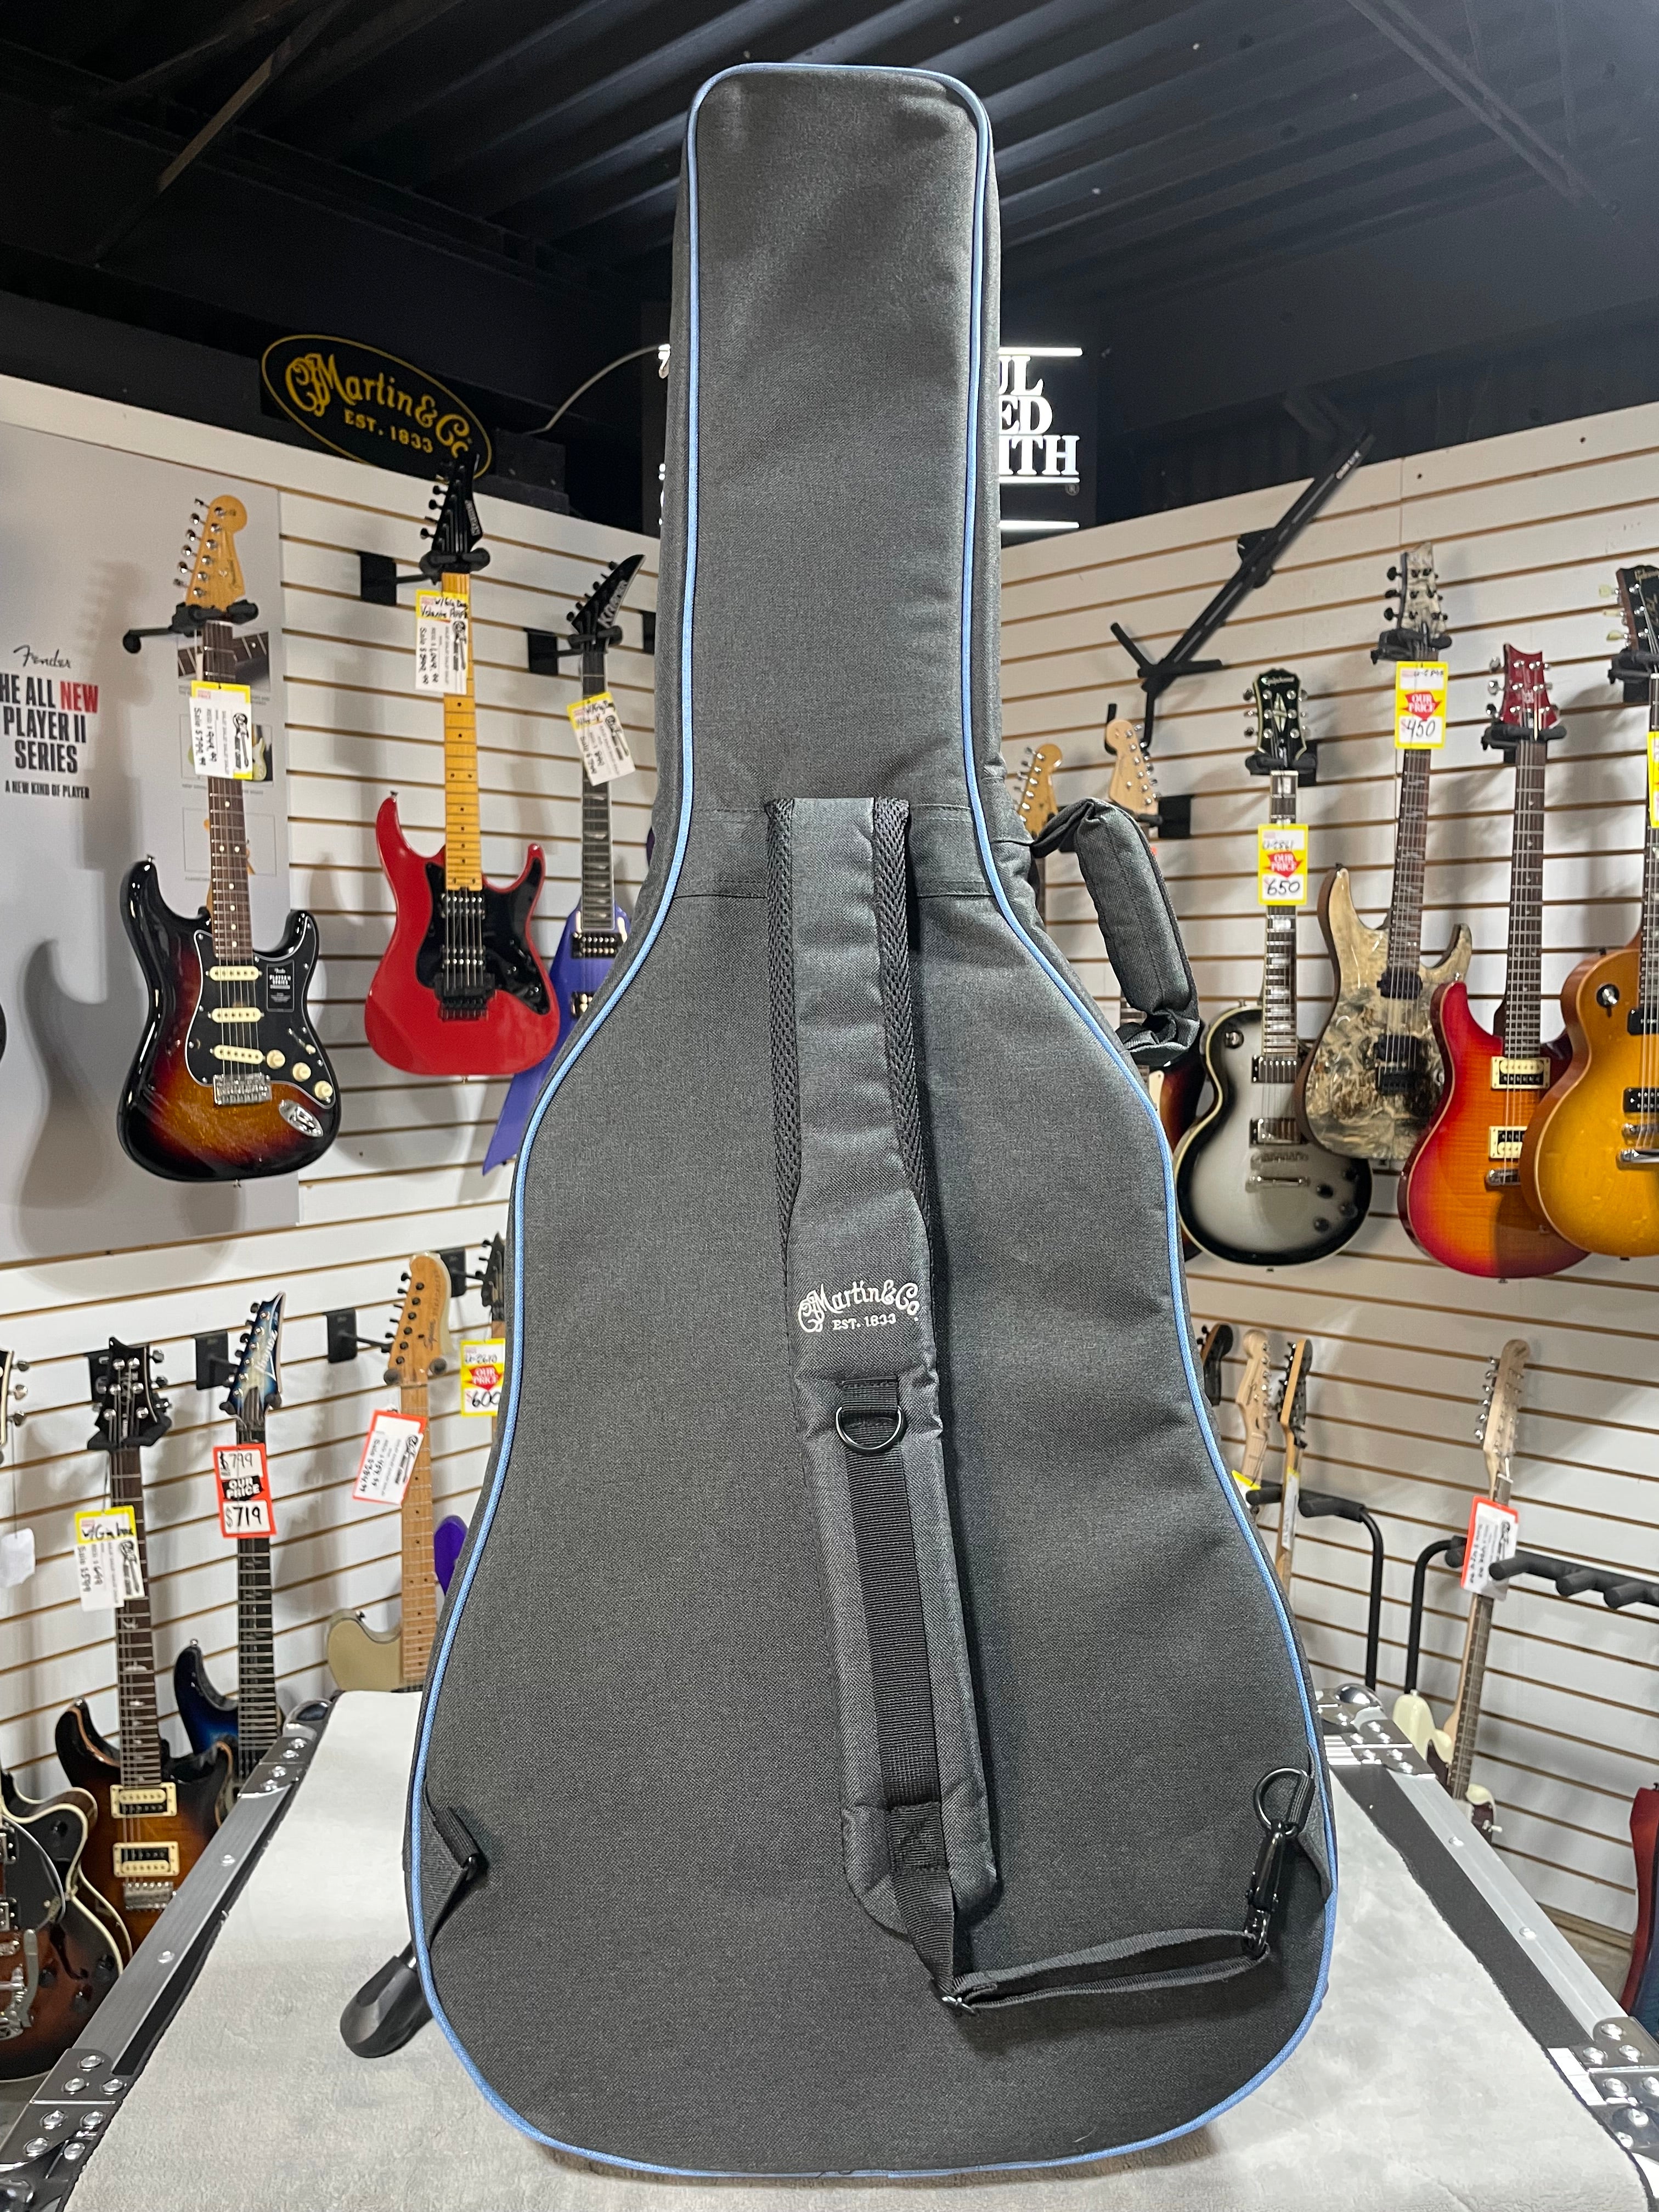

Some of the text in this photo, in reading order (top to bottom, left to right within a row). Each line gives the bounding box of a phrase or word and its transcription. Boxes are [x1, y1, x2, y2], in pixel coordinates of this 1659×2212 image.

[344, 408, 433, 454] EST. 1833
[13, 644, 71, 669] Fender
[26, 676, 57, 708] ALL
[60, 680, 99, 713] NEW
[1412, 694, 1432, 703] OUR
[1408, 702, 1436, 713] PRICE
[3, 706, 86, 743] PLAYER II
[15, 740, 78, 774] SERIES
[1271, 862, 1296, 872] PRICE
[1274, 854, 1294, 863] OUR
[832, 1313, 896, 1330] EST. 1833
[226, 1483, 261, 1499] PRICE
[229, 1477, 253, 1490] OUR
[225, 1506, 262, 1528] $719
